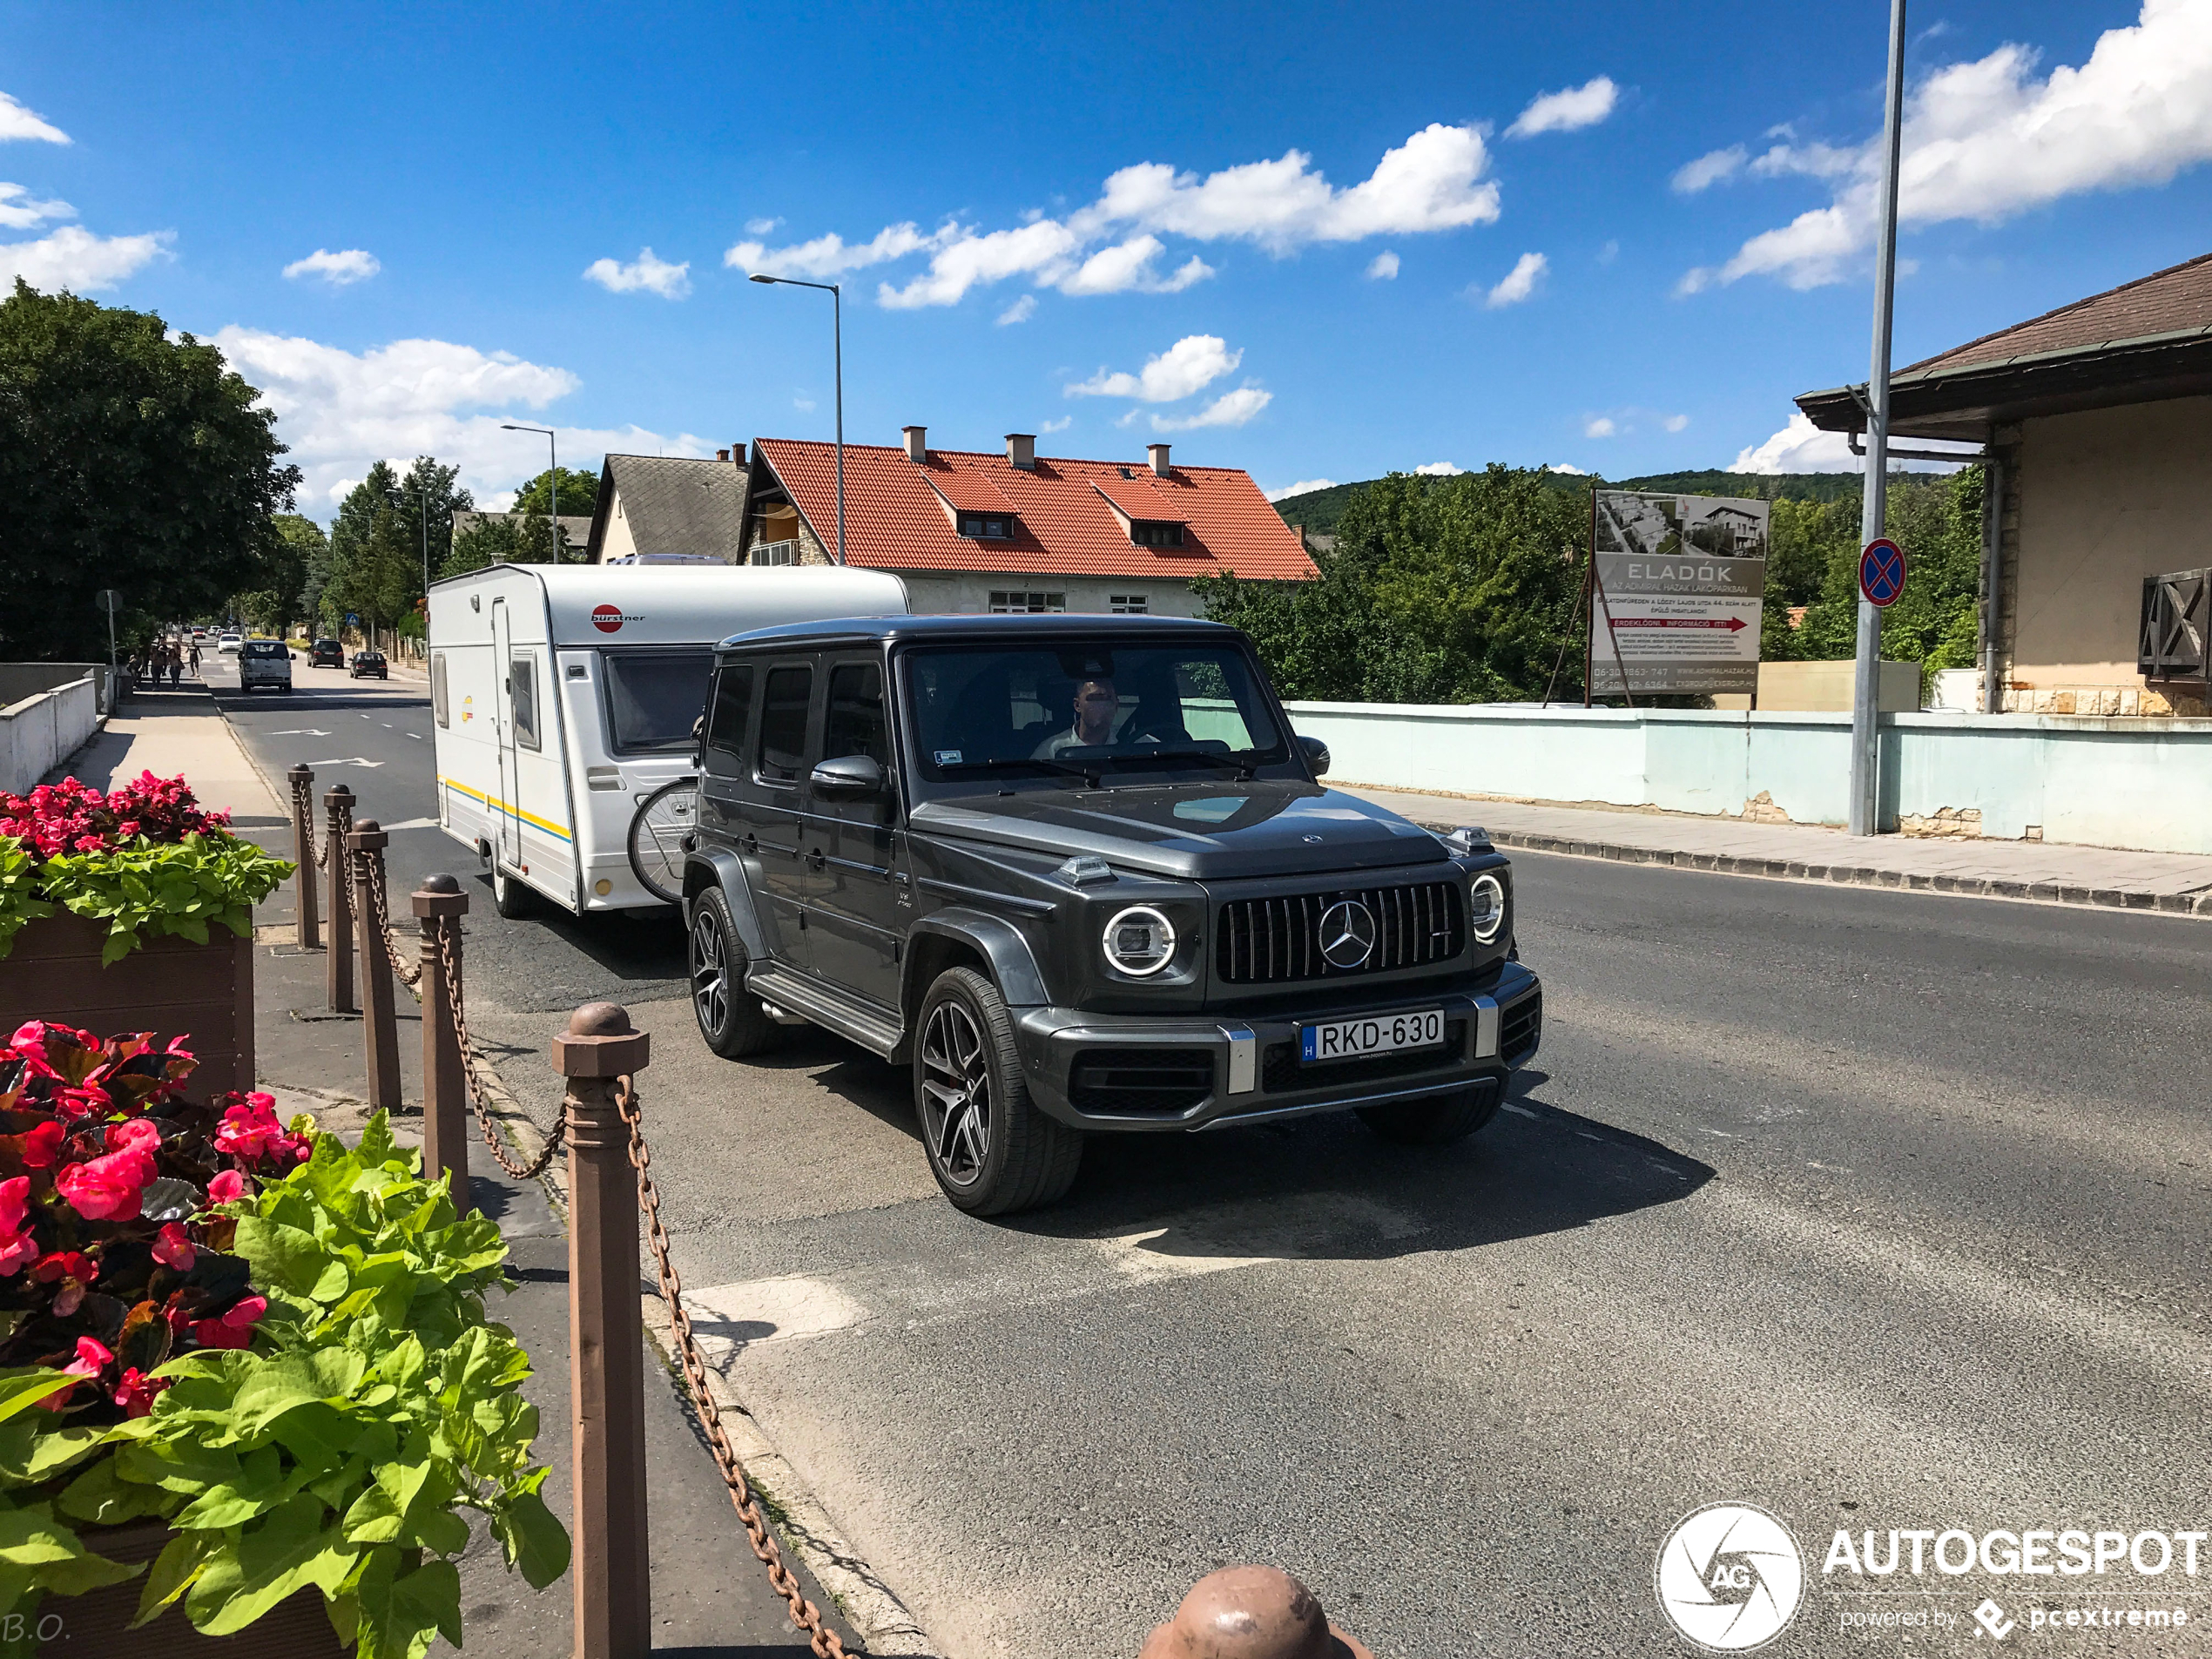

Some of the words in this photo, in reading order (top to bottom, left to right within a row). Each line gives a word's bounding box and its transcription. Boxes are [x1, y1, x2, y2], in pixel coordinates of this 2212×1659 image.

[1629, 561, 1732, 582] ELADÓK
[1323, 1014, 1439, 1055] RKD-630
[1305, 1046, 1312, 1056] H
